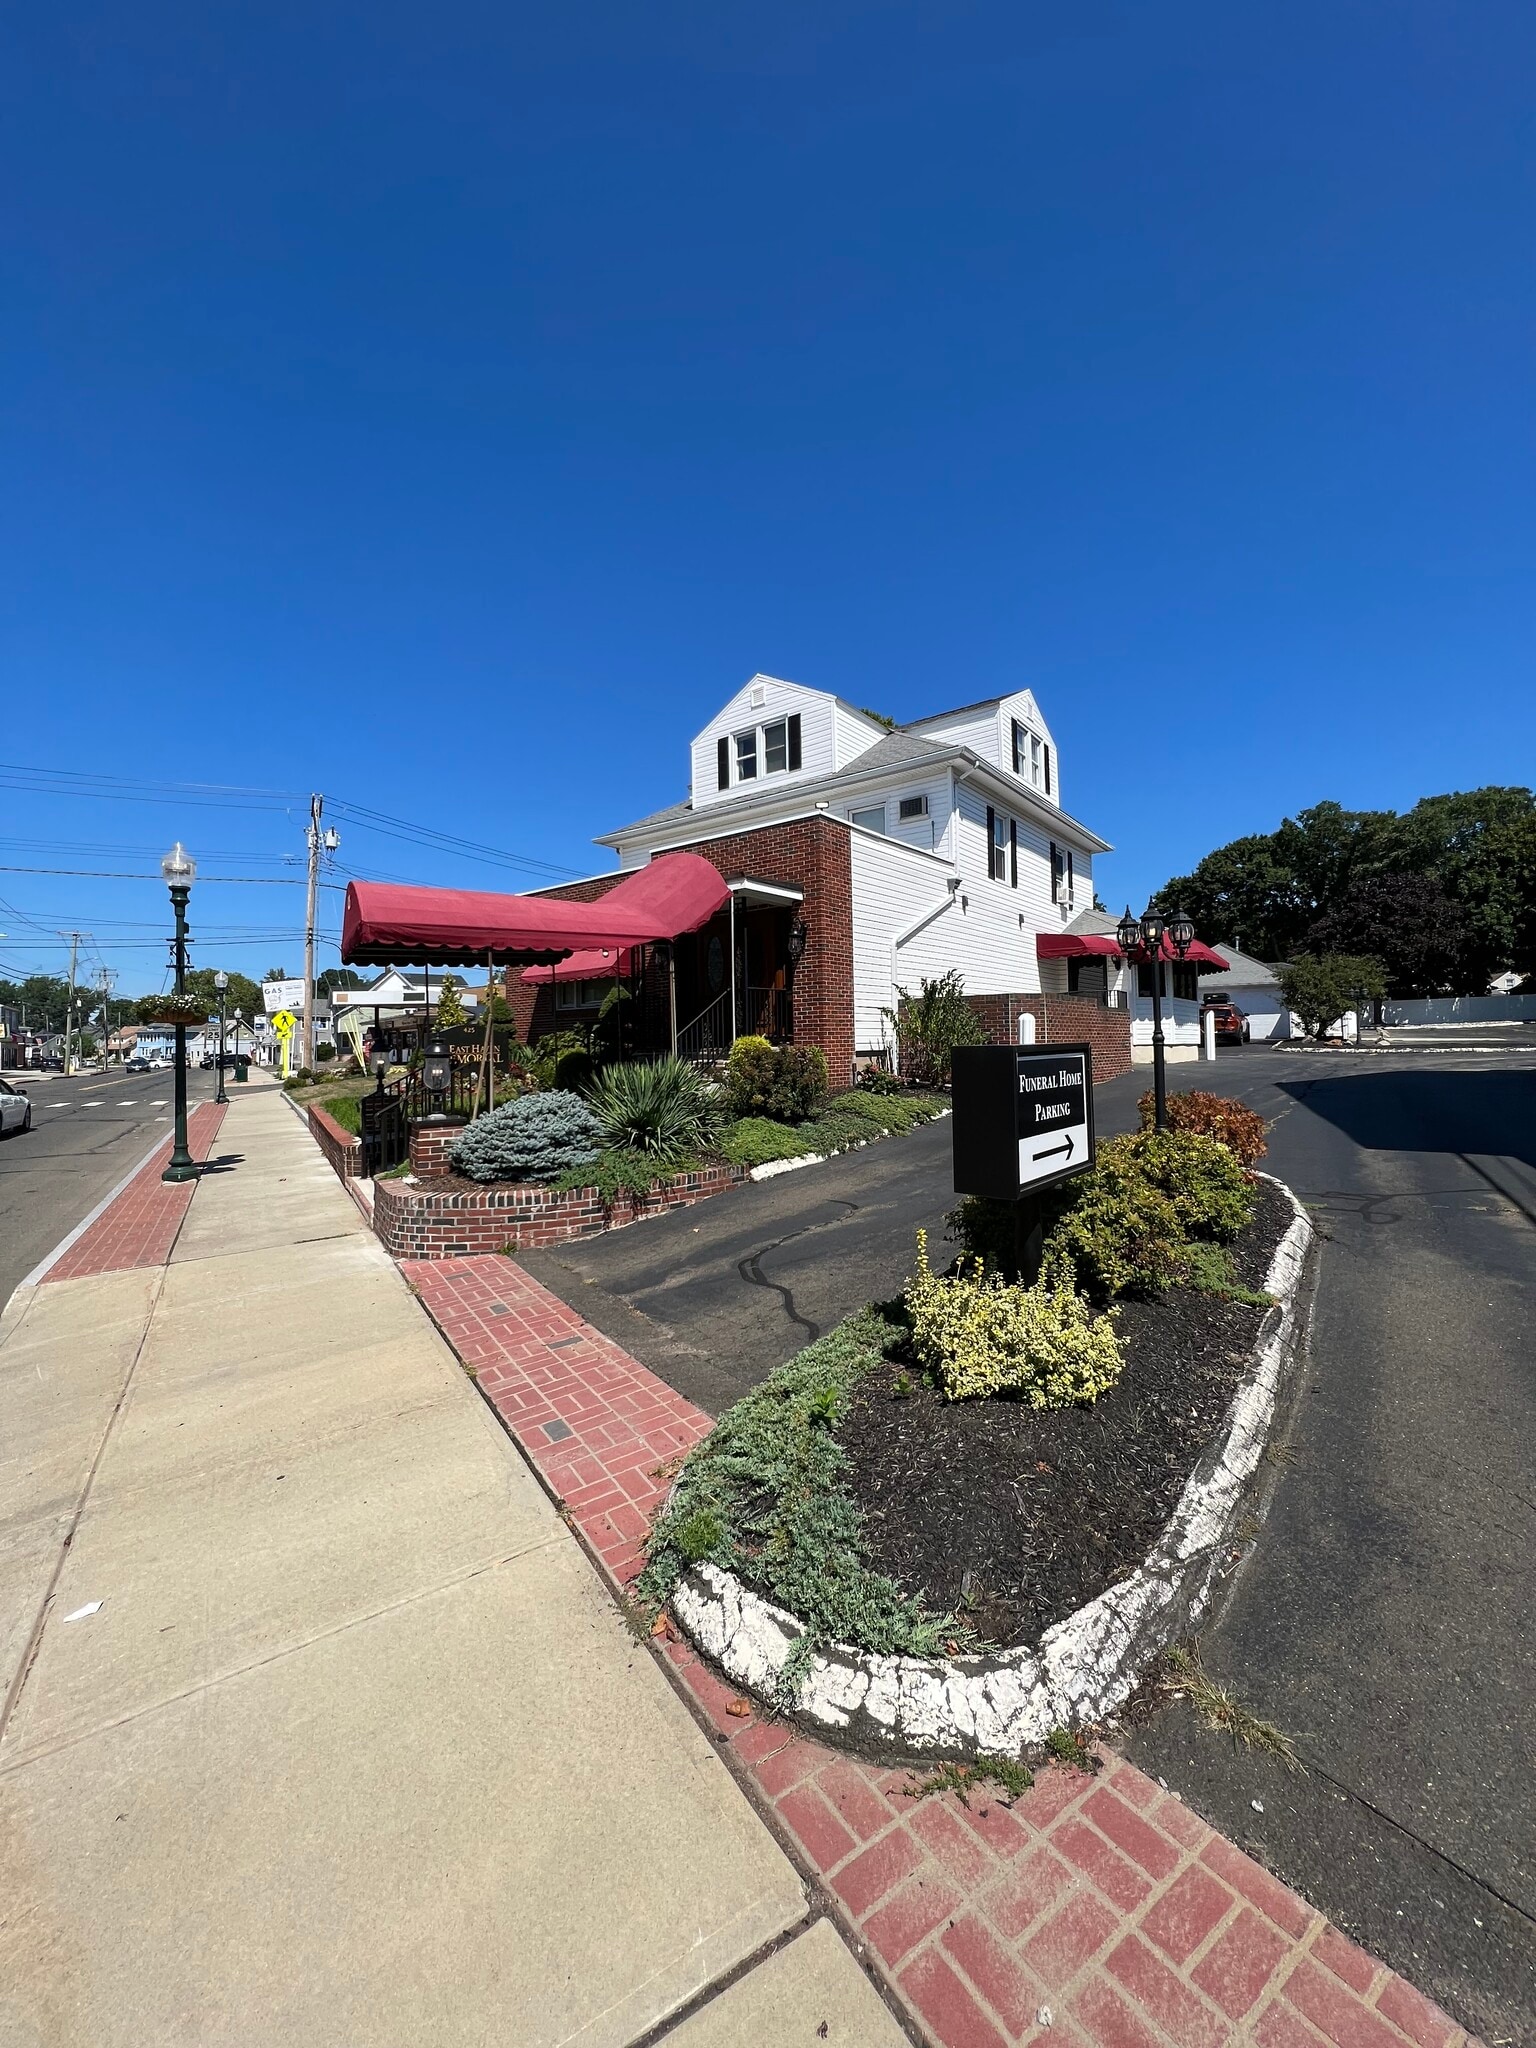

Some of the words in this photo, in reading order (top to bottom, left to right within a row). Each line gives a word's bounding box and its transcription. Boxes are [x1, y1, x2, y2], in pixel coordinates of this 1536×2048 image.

[264, 987, 282, 995] GAS
[449, 1044, 470, 1053] EAST
[471, 1044, 501, 1053] HAVN
[1019, 1074, 1058, 1093] FUNERAL
[1059, 1070, 1082, 1087] HOME
[1034, 1102, 1071, 1122] PARKING
